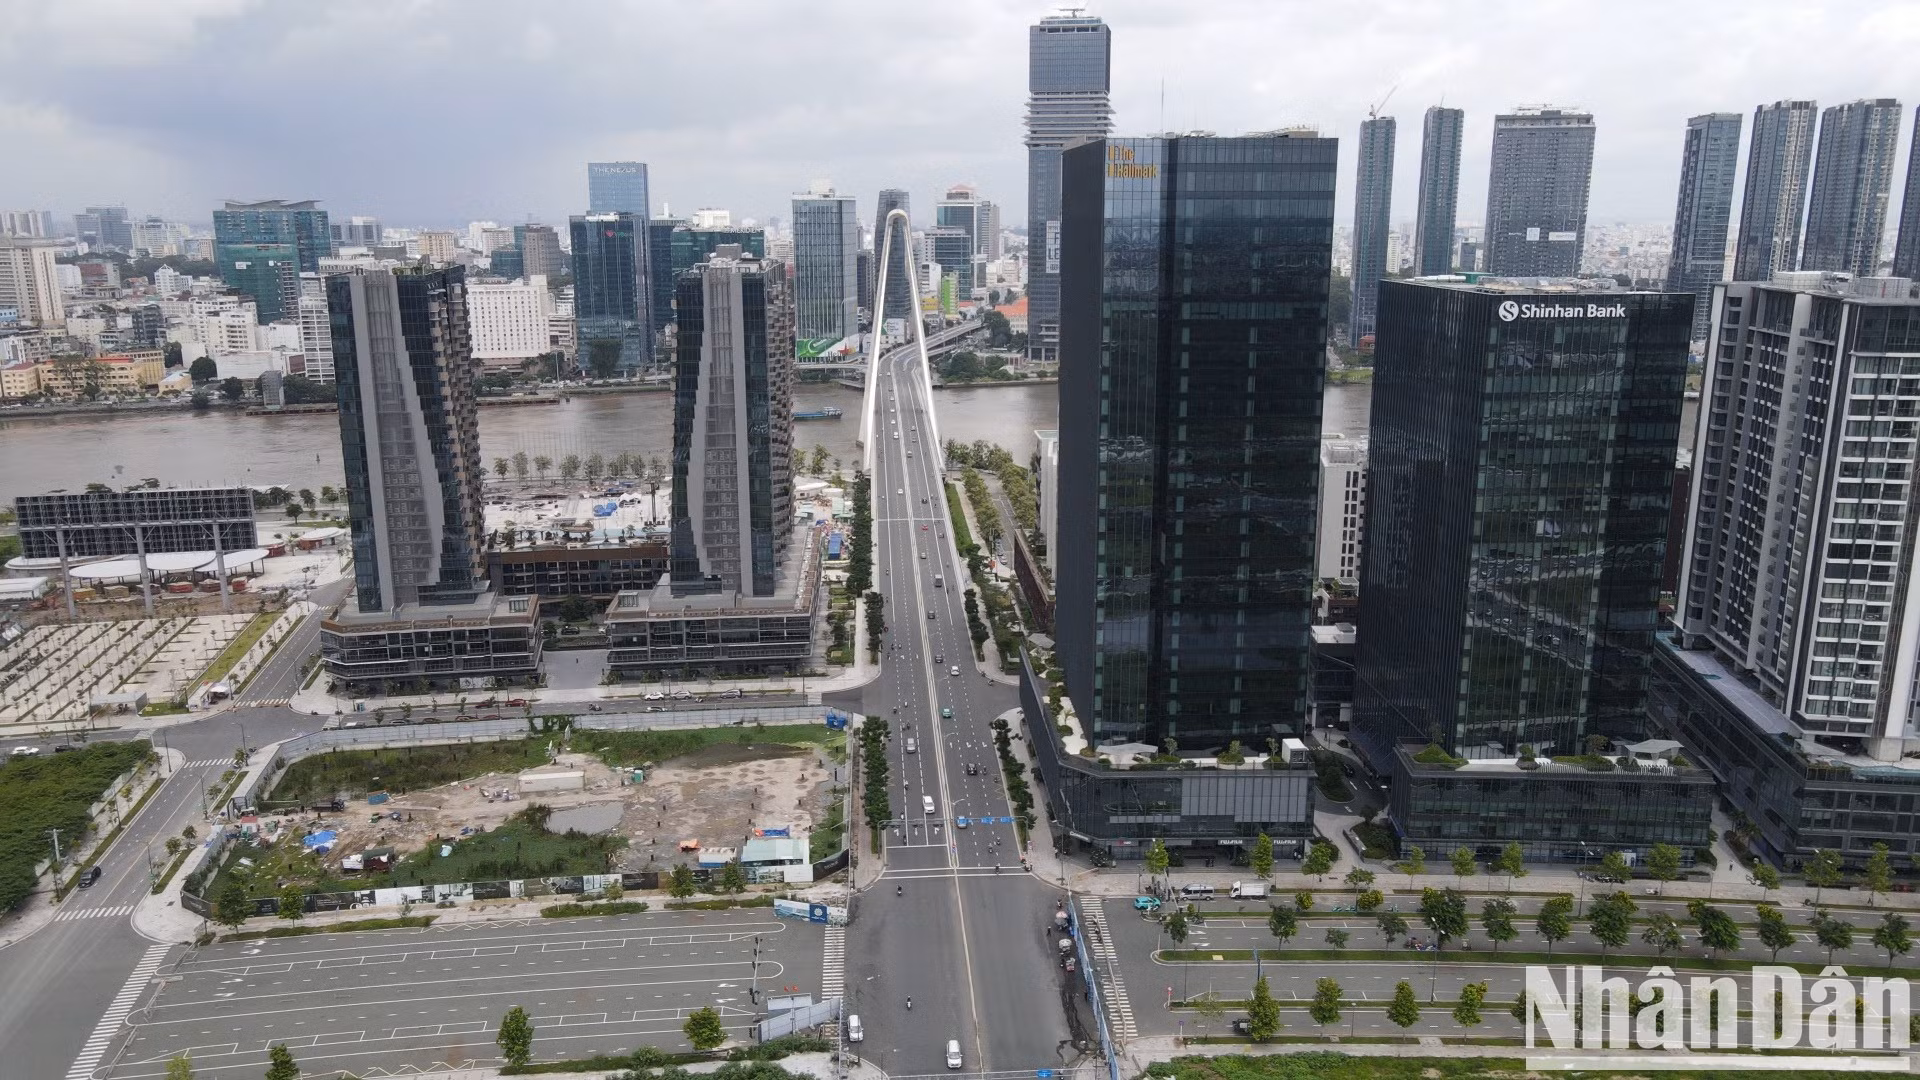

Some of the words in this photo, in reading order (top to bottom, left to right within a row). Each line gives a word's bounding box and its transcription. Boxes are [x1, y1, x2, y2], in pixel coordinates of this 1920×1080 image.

[1118, 163, 1157, 178] Hallmark
[1520, 303, 1584, 318] Shinhan
[1587, 303, 1626, 318] Bank
